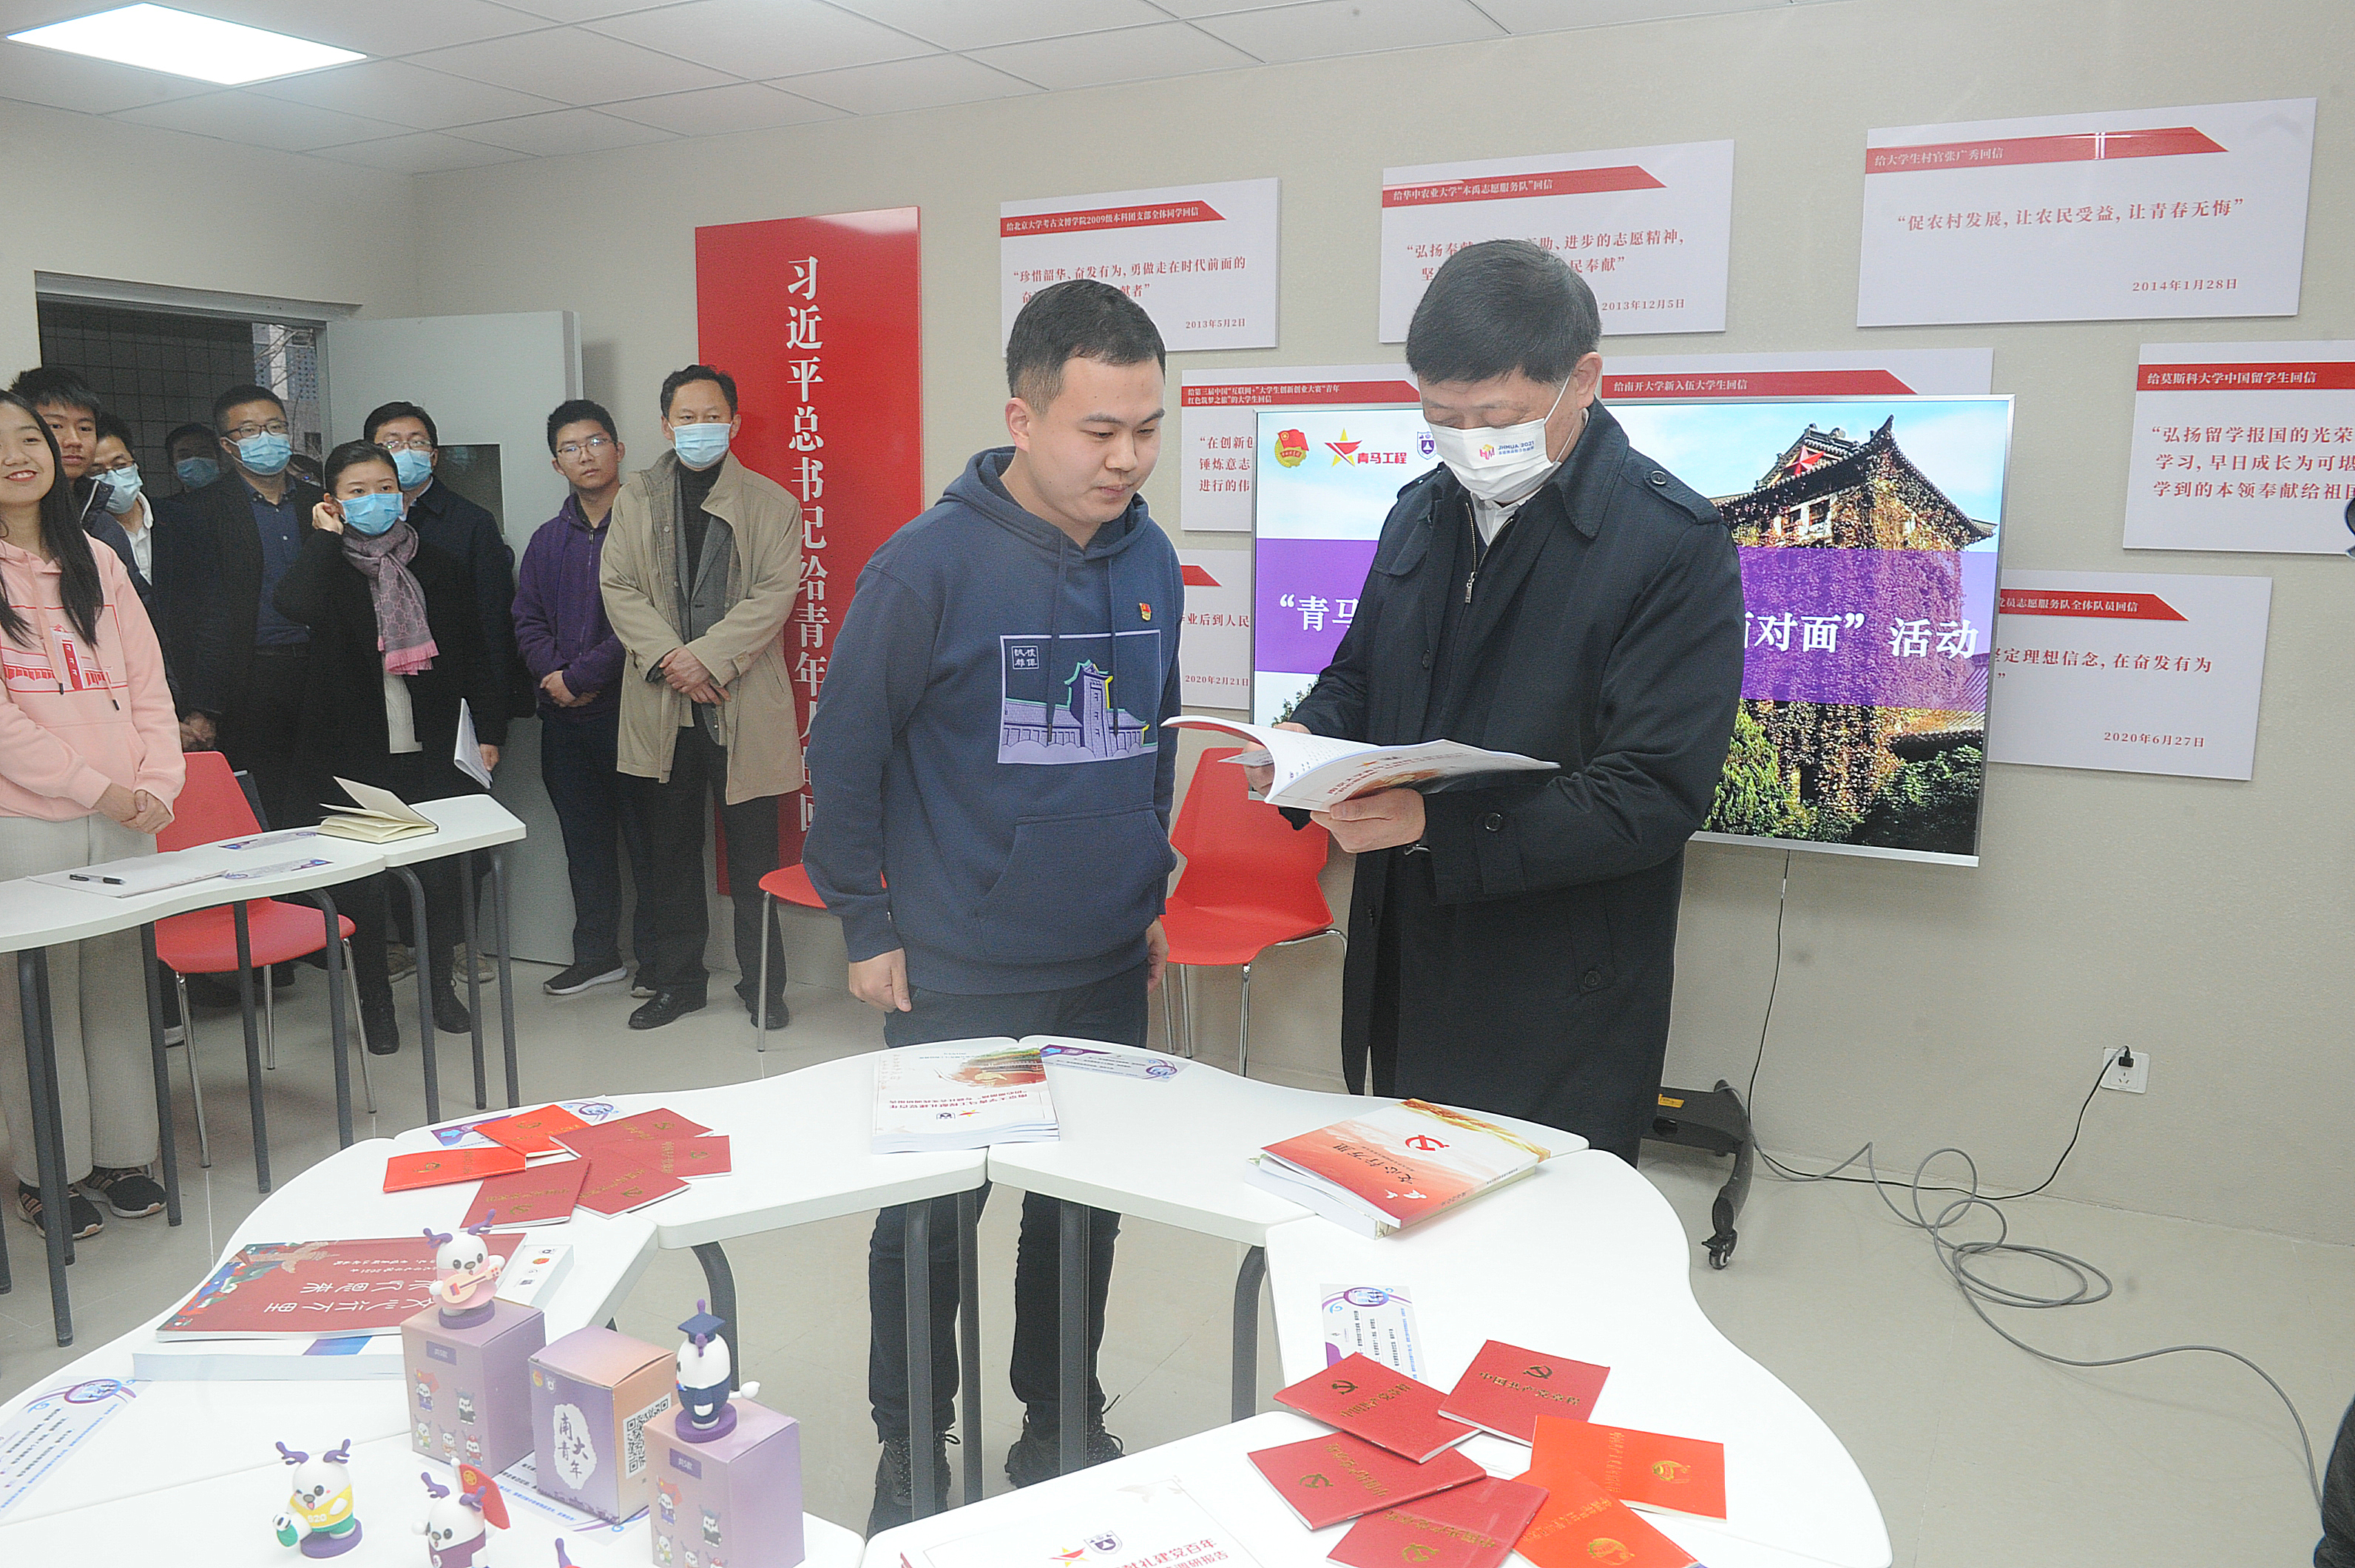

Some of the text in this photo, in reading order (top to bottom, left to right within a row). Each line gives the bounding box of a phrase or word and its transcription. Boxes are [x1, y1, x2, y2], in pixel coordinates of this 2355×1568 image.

[1874, 146, 2004, 167] 给大学生村官张广秀回信
[1531, 229, 1685, 250] 助、进步的志愿精神，
[2132, 278, 2238, 292] 2014年1月28日
[1601, 297, 1686, 311] 2013年12月5日
[1186, 318, 1246, 328] 2013年5月2日
[2147, 371, 2317, 385] 给莫斯科大学中国留学生回信
[1613, 379, 1748, 393] 给南开大学新入伍大学生回信
[2152, 426, 2354, 444] “弘扬留学报国的光荣
[1200, 457, 1251, 471] 锤炼意志
[1357, 452, 1408, 464] 青马工程
[1200, 479, 1250, 493] 进行的伟
[1182, 613, 1250, 627] 业后到人民
[1743, 612, 1866, 654] 对面”
[1888, 615, 1980, 660] 活动
[1185, 675, 1249, 687] 2020年2月21日
[2104, 732, 2206, 748] 2020年6月27日
[1479, 1371, 1581, 1406] 中国共产党章程
[1339, 1382, 1413, 1419] 中国共产党章程
